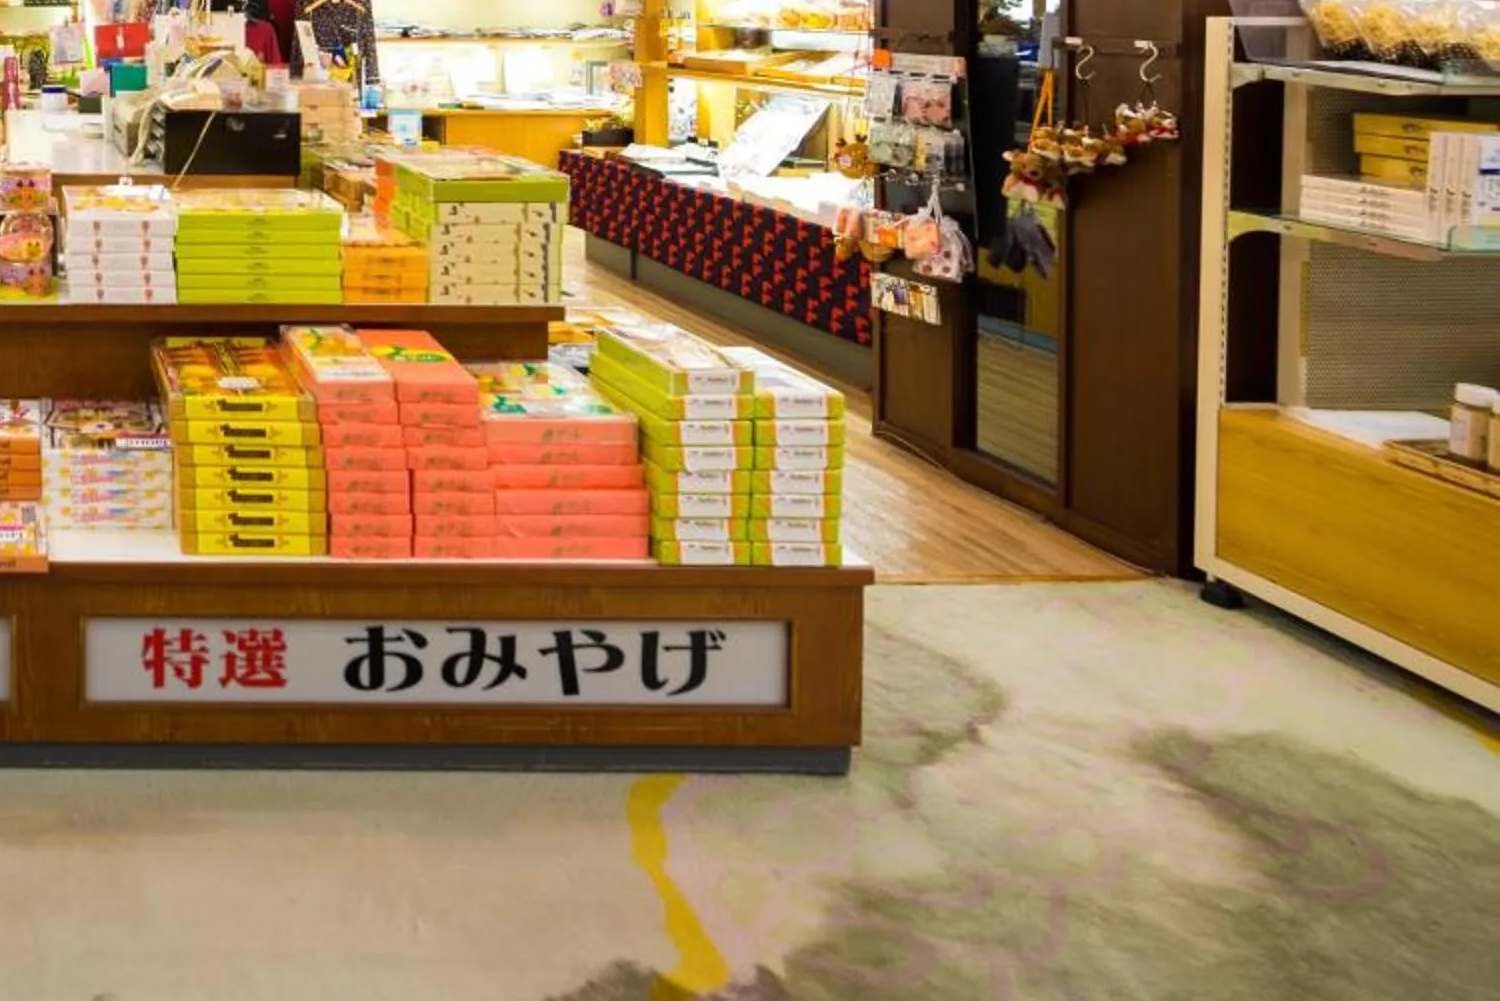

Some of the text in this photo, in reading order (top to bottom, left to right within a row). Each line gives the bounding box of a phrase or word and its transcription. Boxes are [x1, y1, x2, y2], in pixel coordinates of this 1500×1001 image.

[140, 624, 727, 697] 特選 おみやげ
